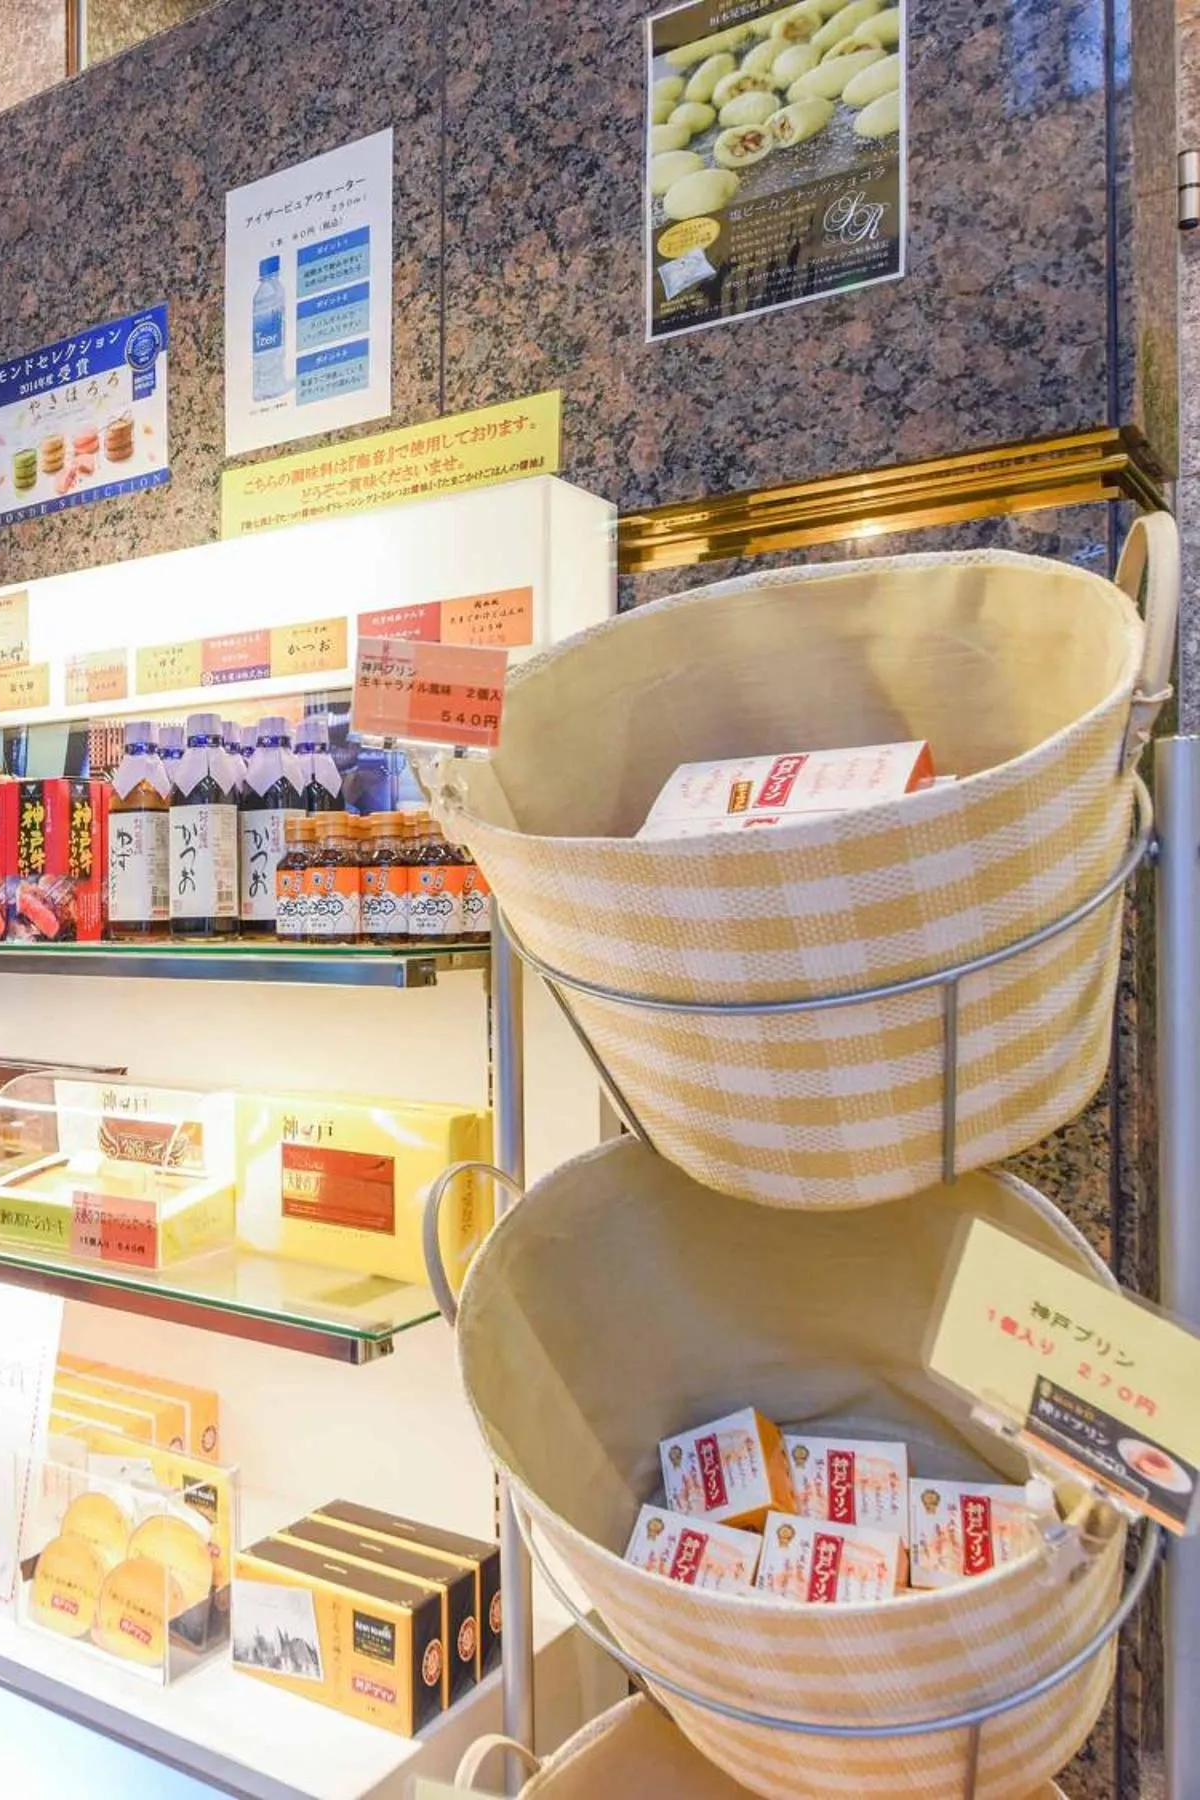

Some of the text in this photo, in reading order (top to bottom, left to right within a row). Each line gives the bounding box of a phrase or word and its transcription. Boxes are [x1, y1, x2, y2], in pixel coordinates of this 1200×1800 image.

[59, 472, 162, 508] SELECTION
[359, 677, 452, 697] 生キャラメル風味
[360, 661, 417, 677] 神戸プリン
[440, 711, 499, 729] 540円
[174, 822, 198, 896] かつお
[245, 828, 270, 898] かつお
[1030, 1299, 1135, 1368] 神戸プリン
[987, 1307, 1055, 1356] 1個入り
[1077, 1361, 1158, 1417] 270円
